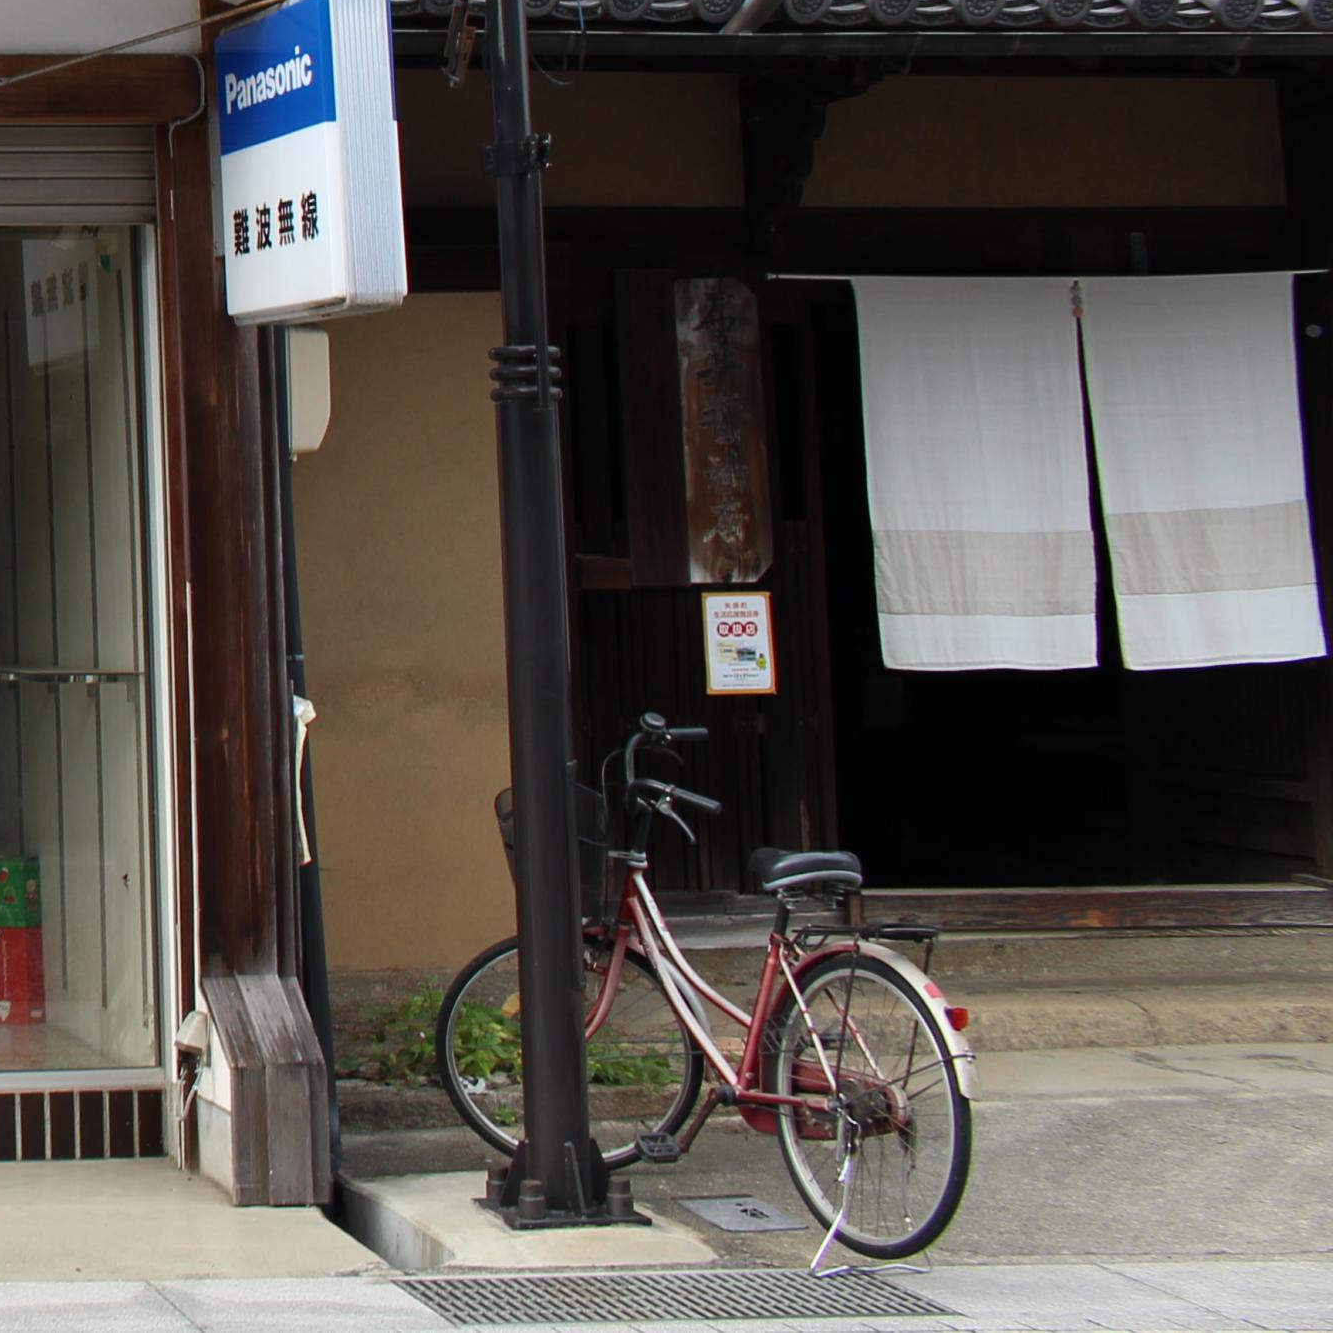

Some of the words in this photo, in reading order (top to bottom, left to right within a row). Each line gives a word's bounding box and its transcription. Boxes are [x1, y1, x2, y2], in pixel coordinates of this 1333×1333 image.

[224, 44, 313, 115] Panasonic
[232, 190, 320, 256] 難波無線
